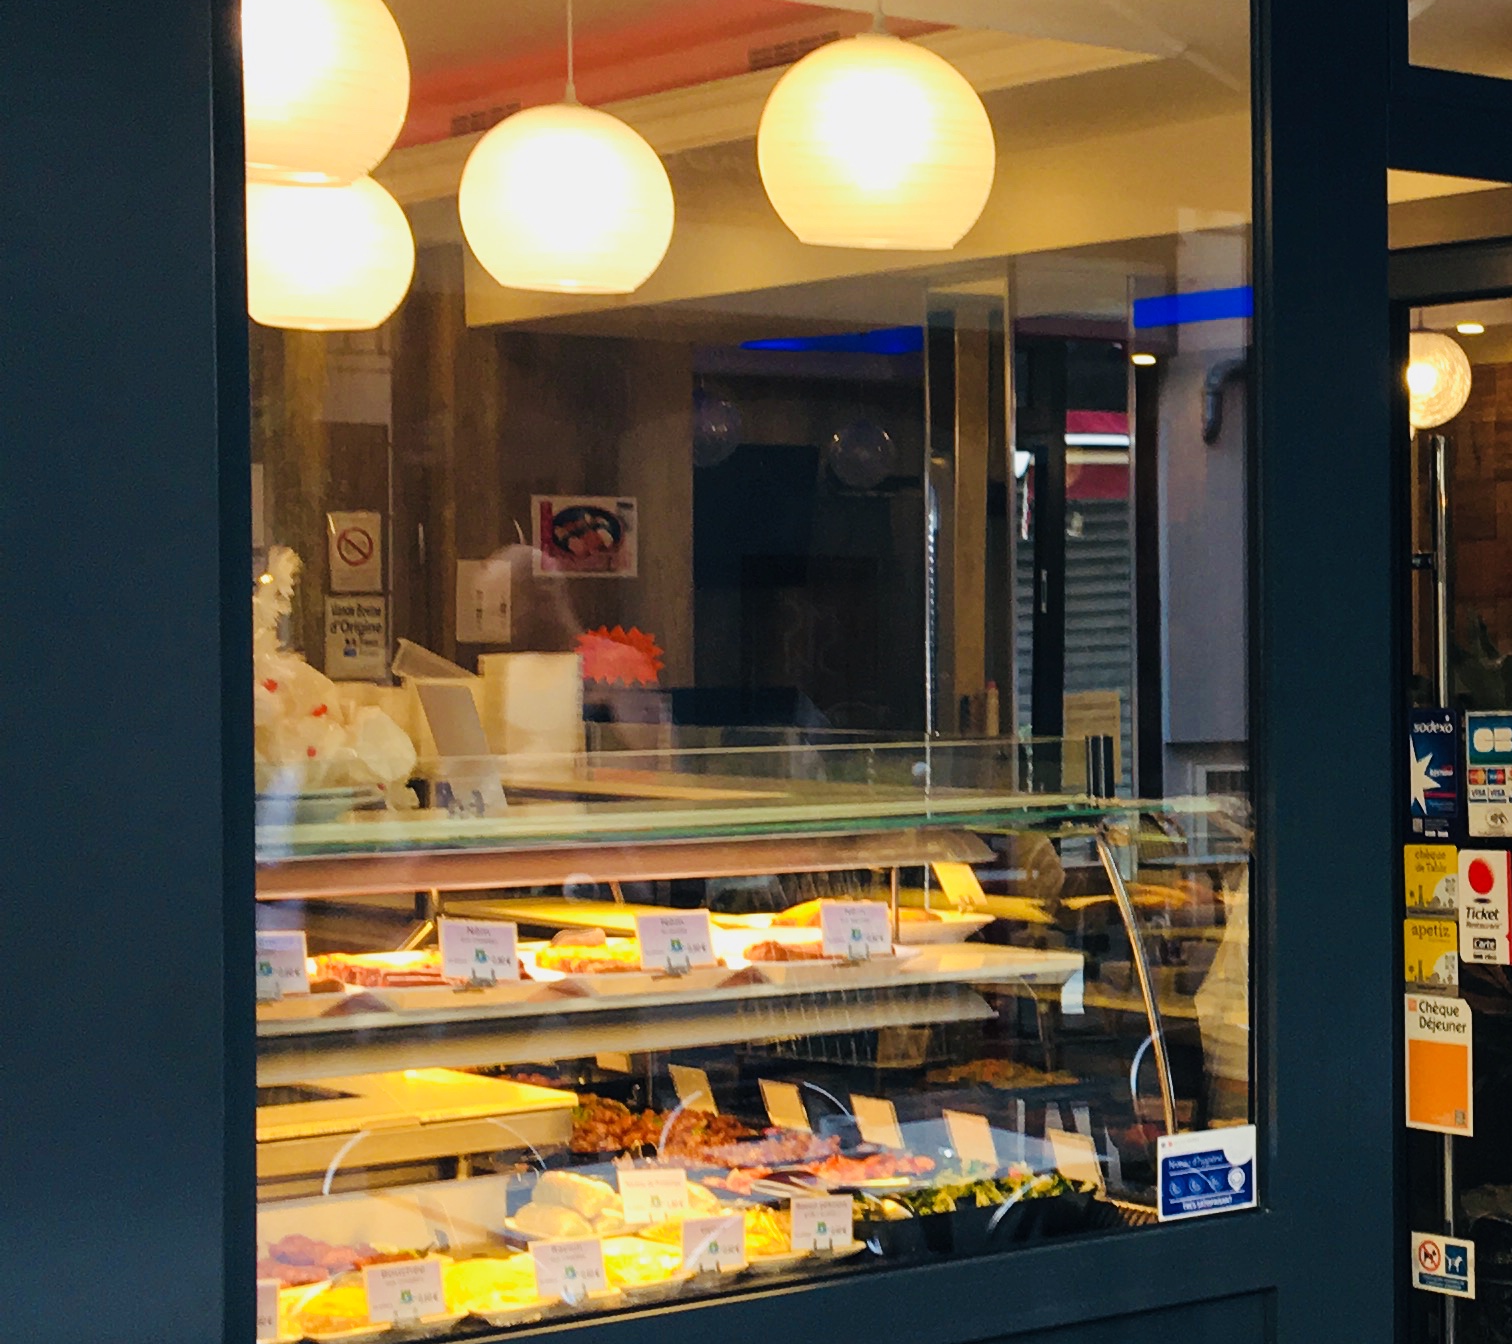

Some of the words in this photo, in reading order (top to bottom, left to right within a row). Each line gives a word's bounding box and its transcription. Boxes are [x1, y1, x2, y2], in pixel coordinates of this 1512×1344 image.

[1466, 907, 1500, 921] Ticket
[1412, 924, 1449, 939] apetiz
[1418, 999, 1460, 1018] Chèque
[1418, 1017, 1467, 1035] Déjeuner
